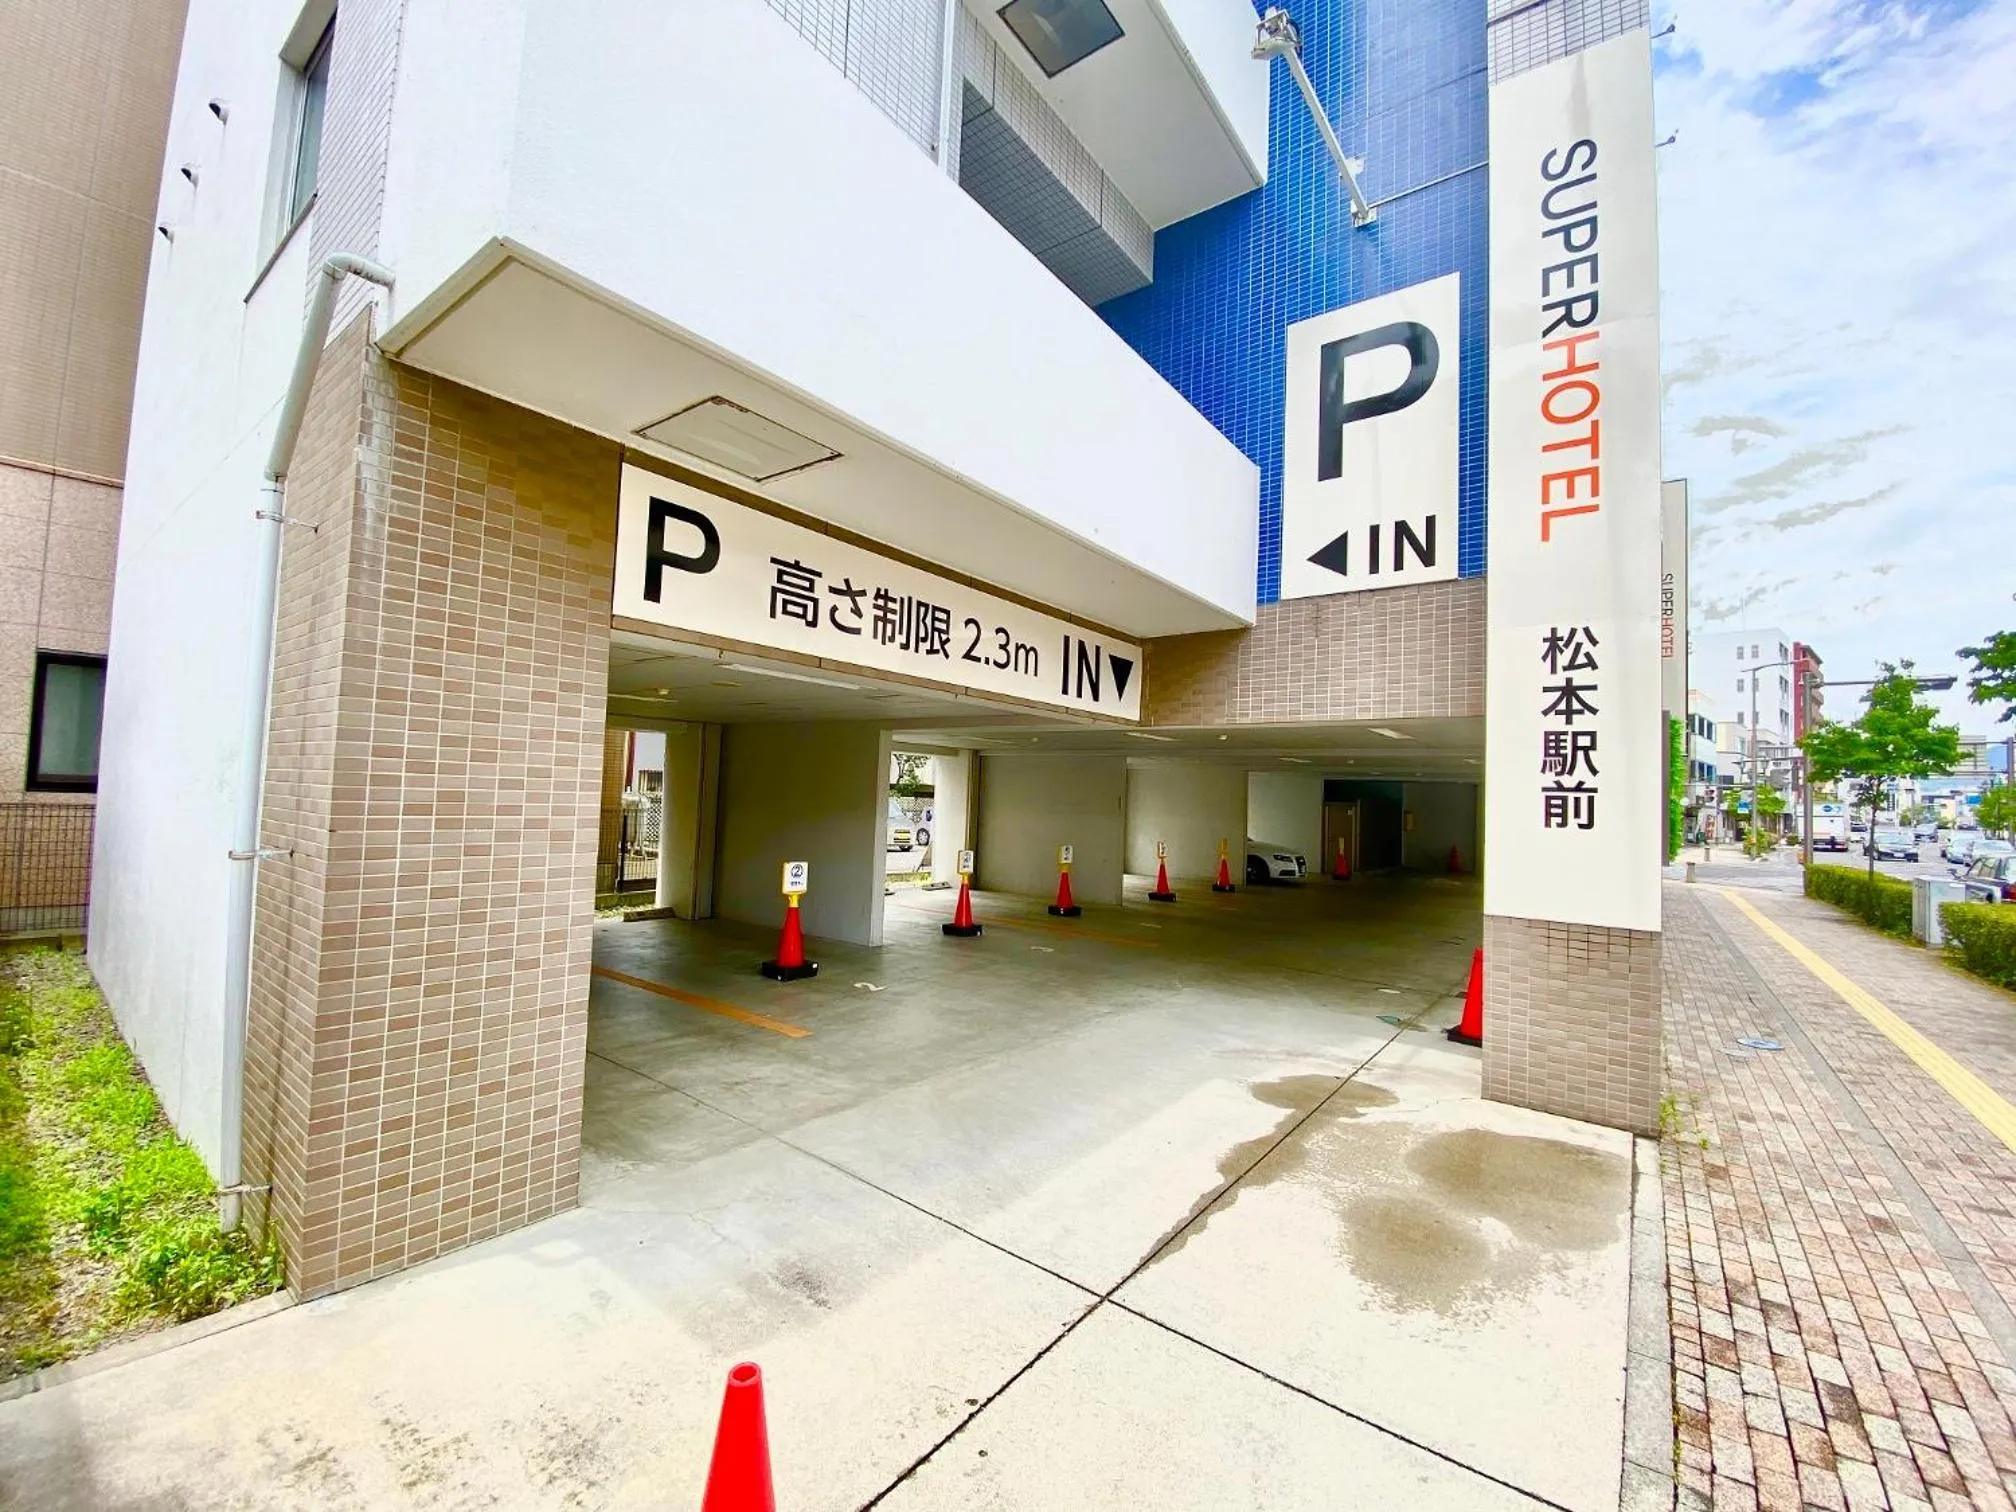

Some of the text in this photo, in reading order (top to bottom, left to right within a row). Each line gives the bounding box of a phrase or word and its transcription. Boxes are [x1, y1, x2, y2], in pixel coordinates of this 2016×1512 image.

[1318, 321, 1438, 482] P
[644, 495, 1102, 703] P 高さ制限 2.3m IN
[1369, 514, 1436, 575] IN
[1540, 626, 1600, 830] 松本駅前
